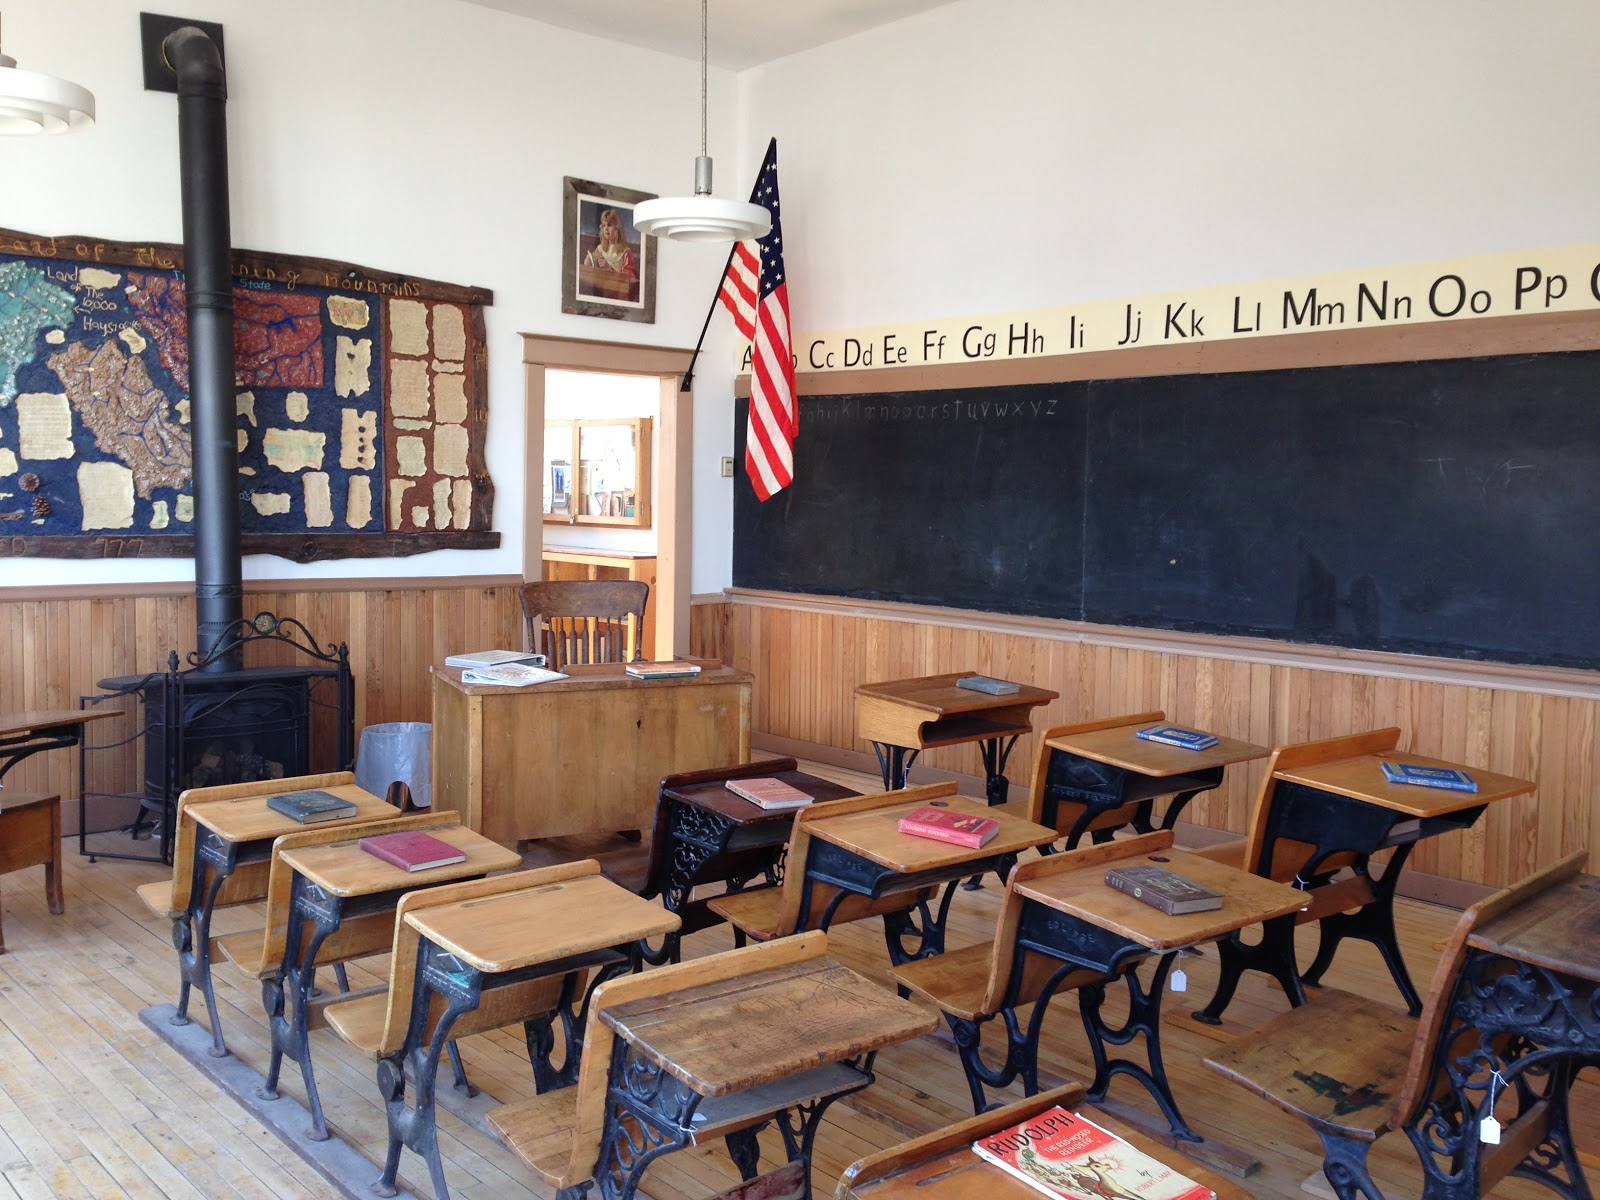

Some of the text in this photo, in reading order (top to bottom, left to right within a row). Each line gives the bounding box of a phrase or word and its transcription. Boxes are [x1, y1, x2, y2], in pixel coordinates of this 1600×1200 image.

[0, 237, 57, 257] and
[239, 278, 271, 291] State
[809, 340, 835, 368] Cc
[844, 338, 873, 367] Dd
[883, 334, 908, 365] Ee
[923, 330, 947, 361] Ff
[962, 326, 996, 358] Gg
[1008, 322, 1045, 355] Hh
[1070, 315, 1084, 349] Ii
[1118, 304, 1142, 345] Jj
[1164, 302, 1205, 339] Kk
[1233, 296, 1261, 333] Ll
[1282, 288, 1345, 329] Mm
[1357, 280, 1412, 322] Nn
[1428, 274, 1492, 318] Oo
[1515, 266, 1568, 310] Pp
[987, 1113, 1075, 1157] RUDOLPH
[1045, 1128, 1091, 1154] THE RED-NOSED
[1059, 1137, 1094, 1157] REINDEER
[1136, 1168, 1154, 1179] by
